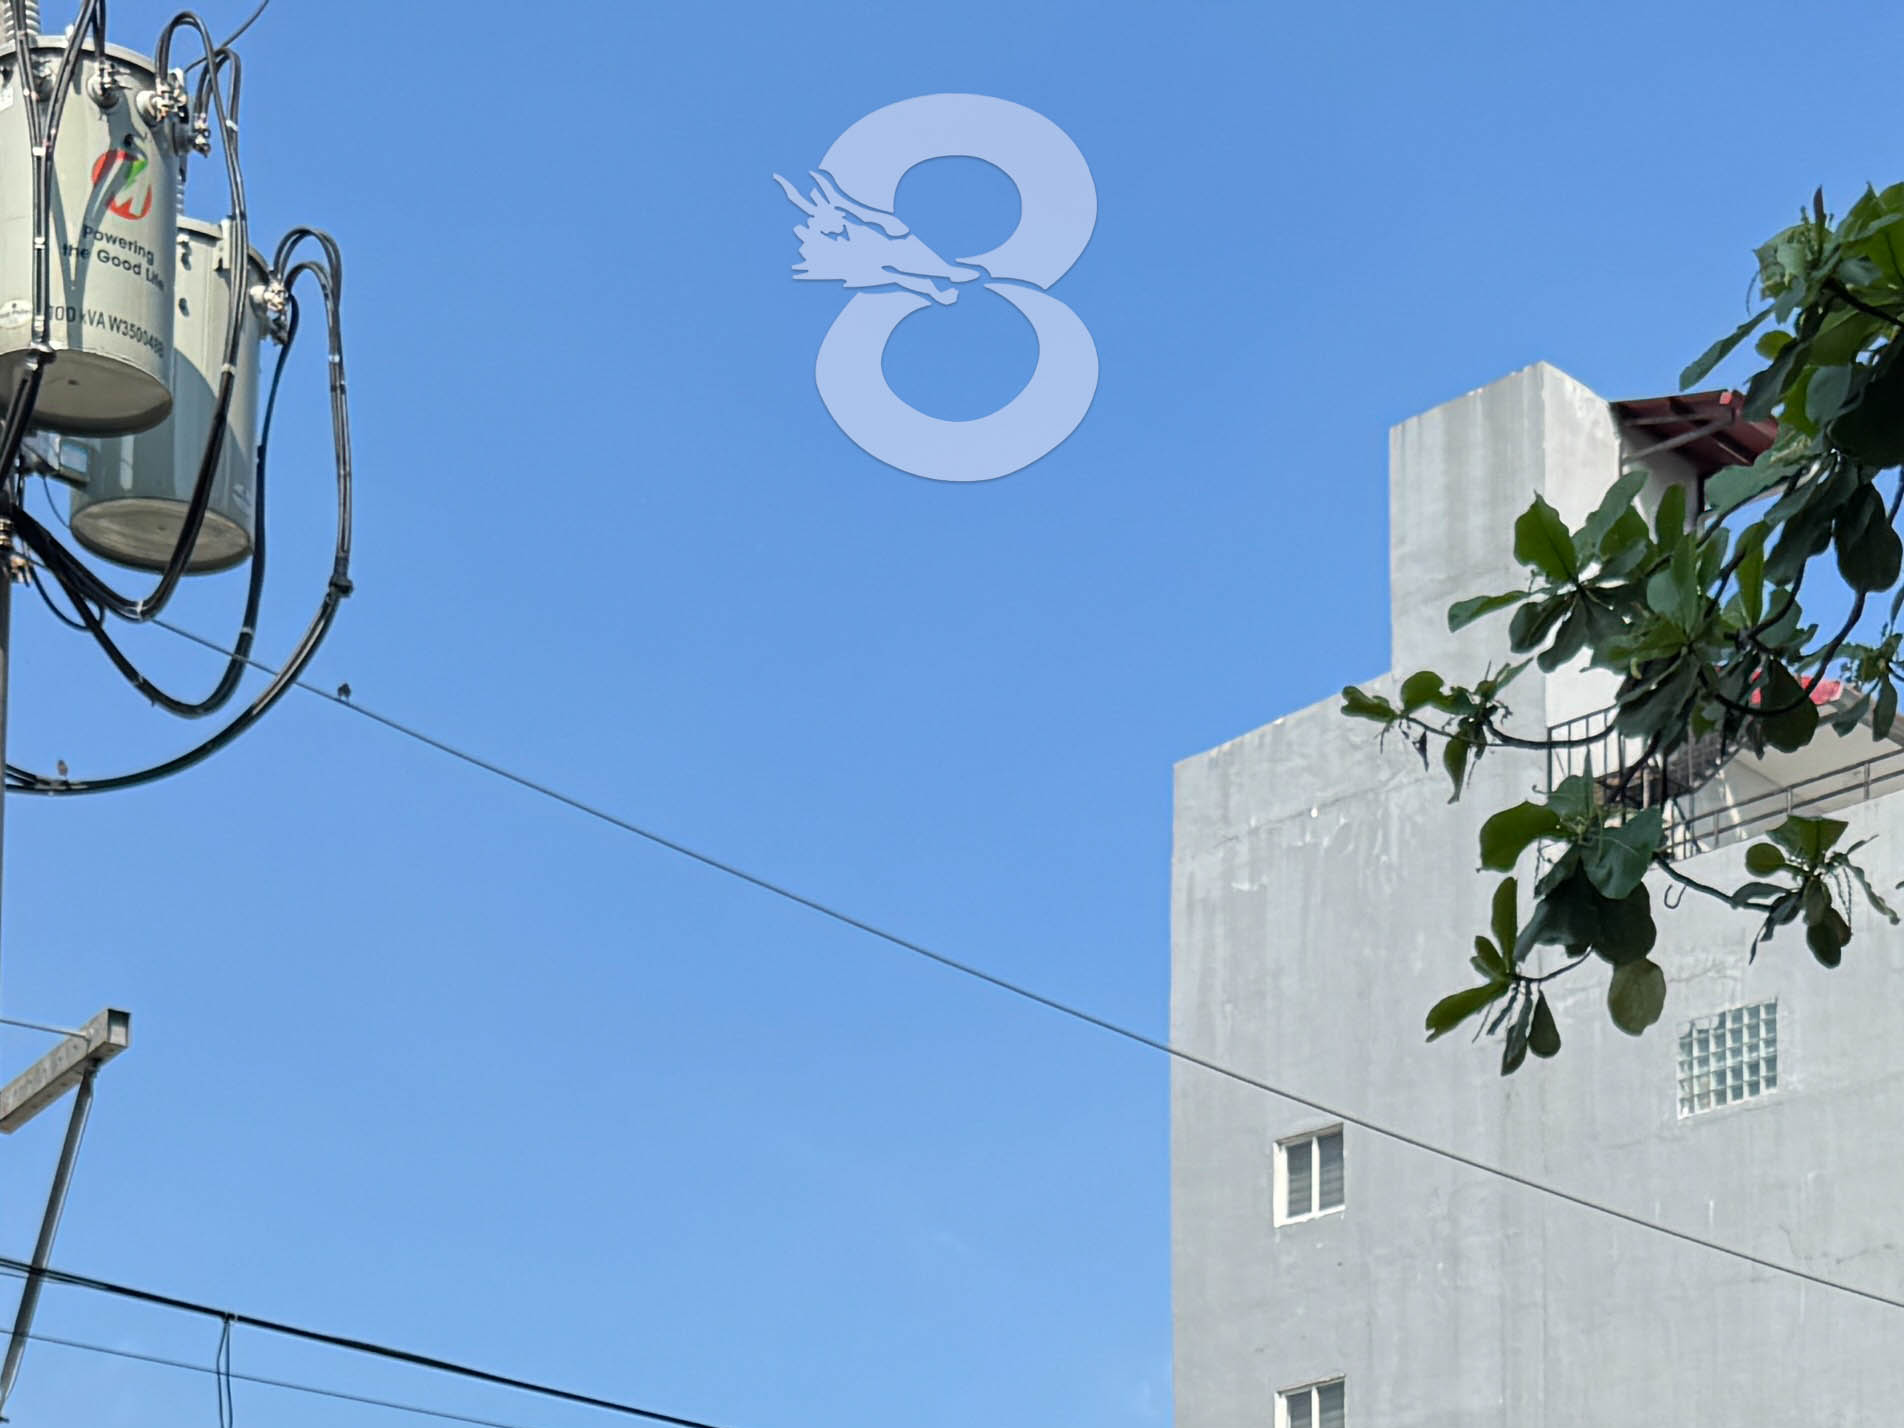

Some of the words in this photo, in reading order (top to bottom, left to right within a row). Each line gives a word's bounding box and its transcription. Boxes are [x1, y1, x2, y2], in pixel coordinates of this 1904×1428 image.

[62, 243, 91, 260] the
[97, 249, 142, 275] Good
[82, 223, 155, 266] Powering
